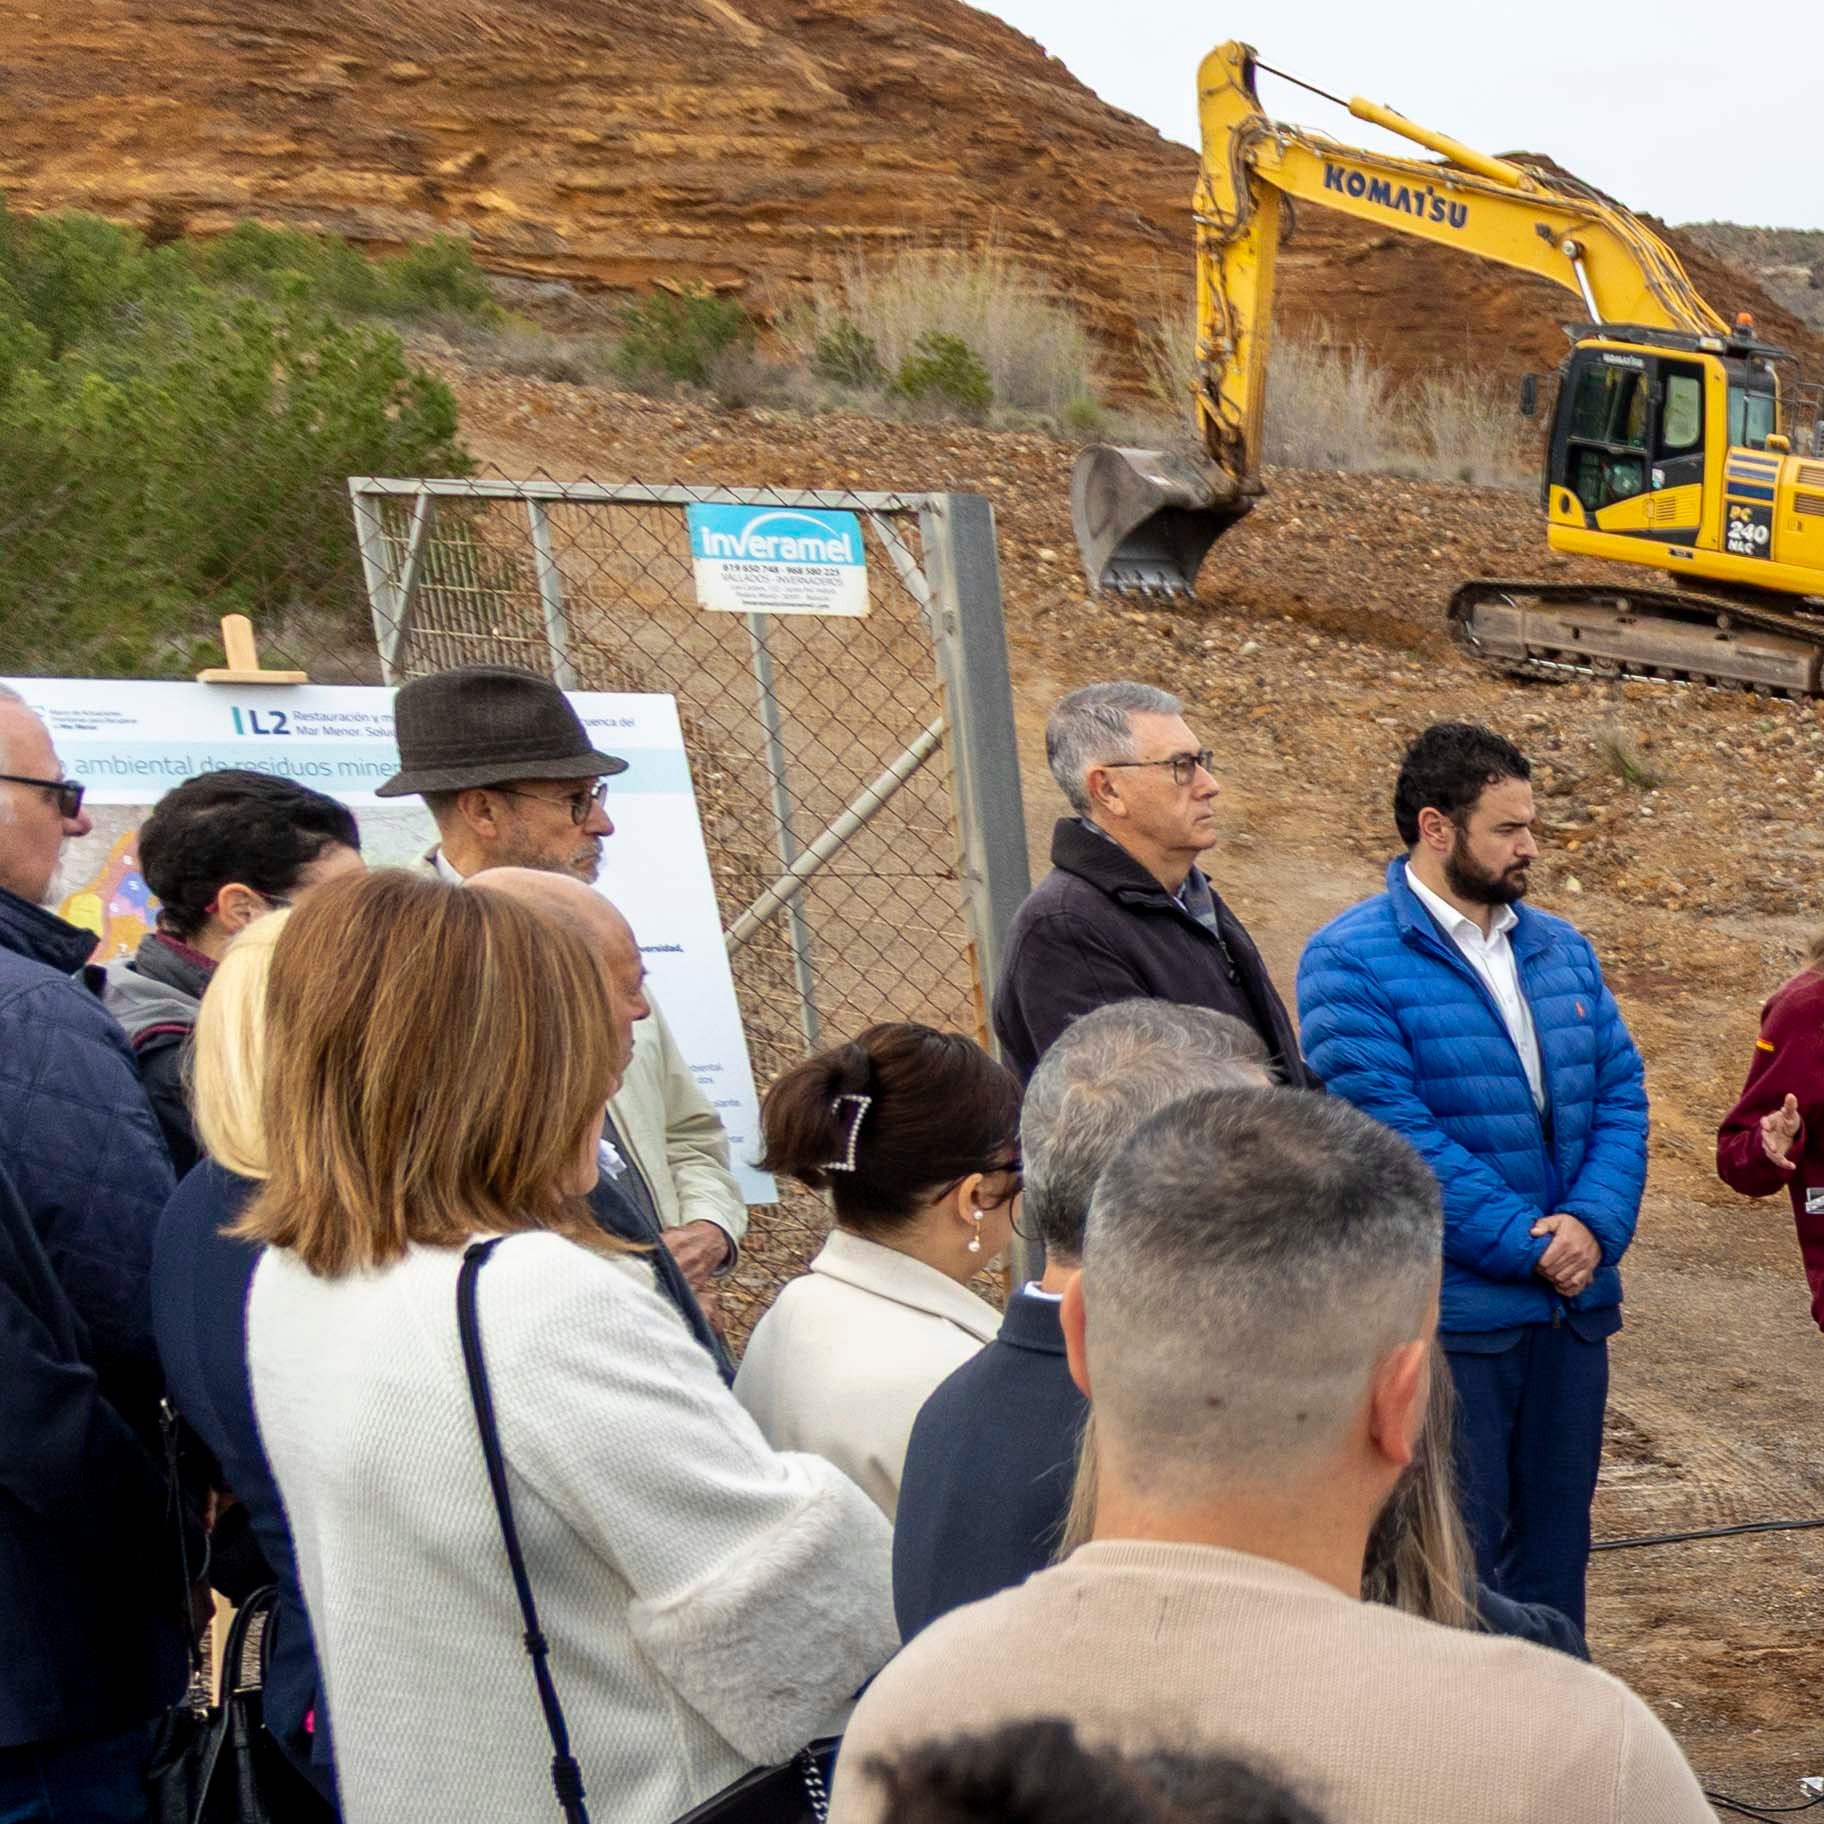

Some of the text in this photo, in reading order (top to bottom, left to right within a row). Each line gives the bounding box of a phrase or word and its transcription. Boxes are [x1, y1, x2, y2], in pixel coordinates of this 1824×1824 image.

[1324, 162, 1468, 228] KOMATSU
[1728, 521, 1769, 544] 240
[702, 526, 854, 563] inveramel
[293, 710, 370, 722] Restauración
[296, 726, 319, 736] Mar
[76, 755, 193, 775] ambiental
